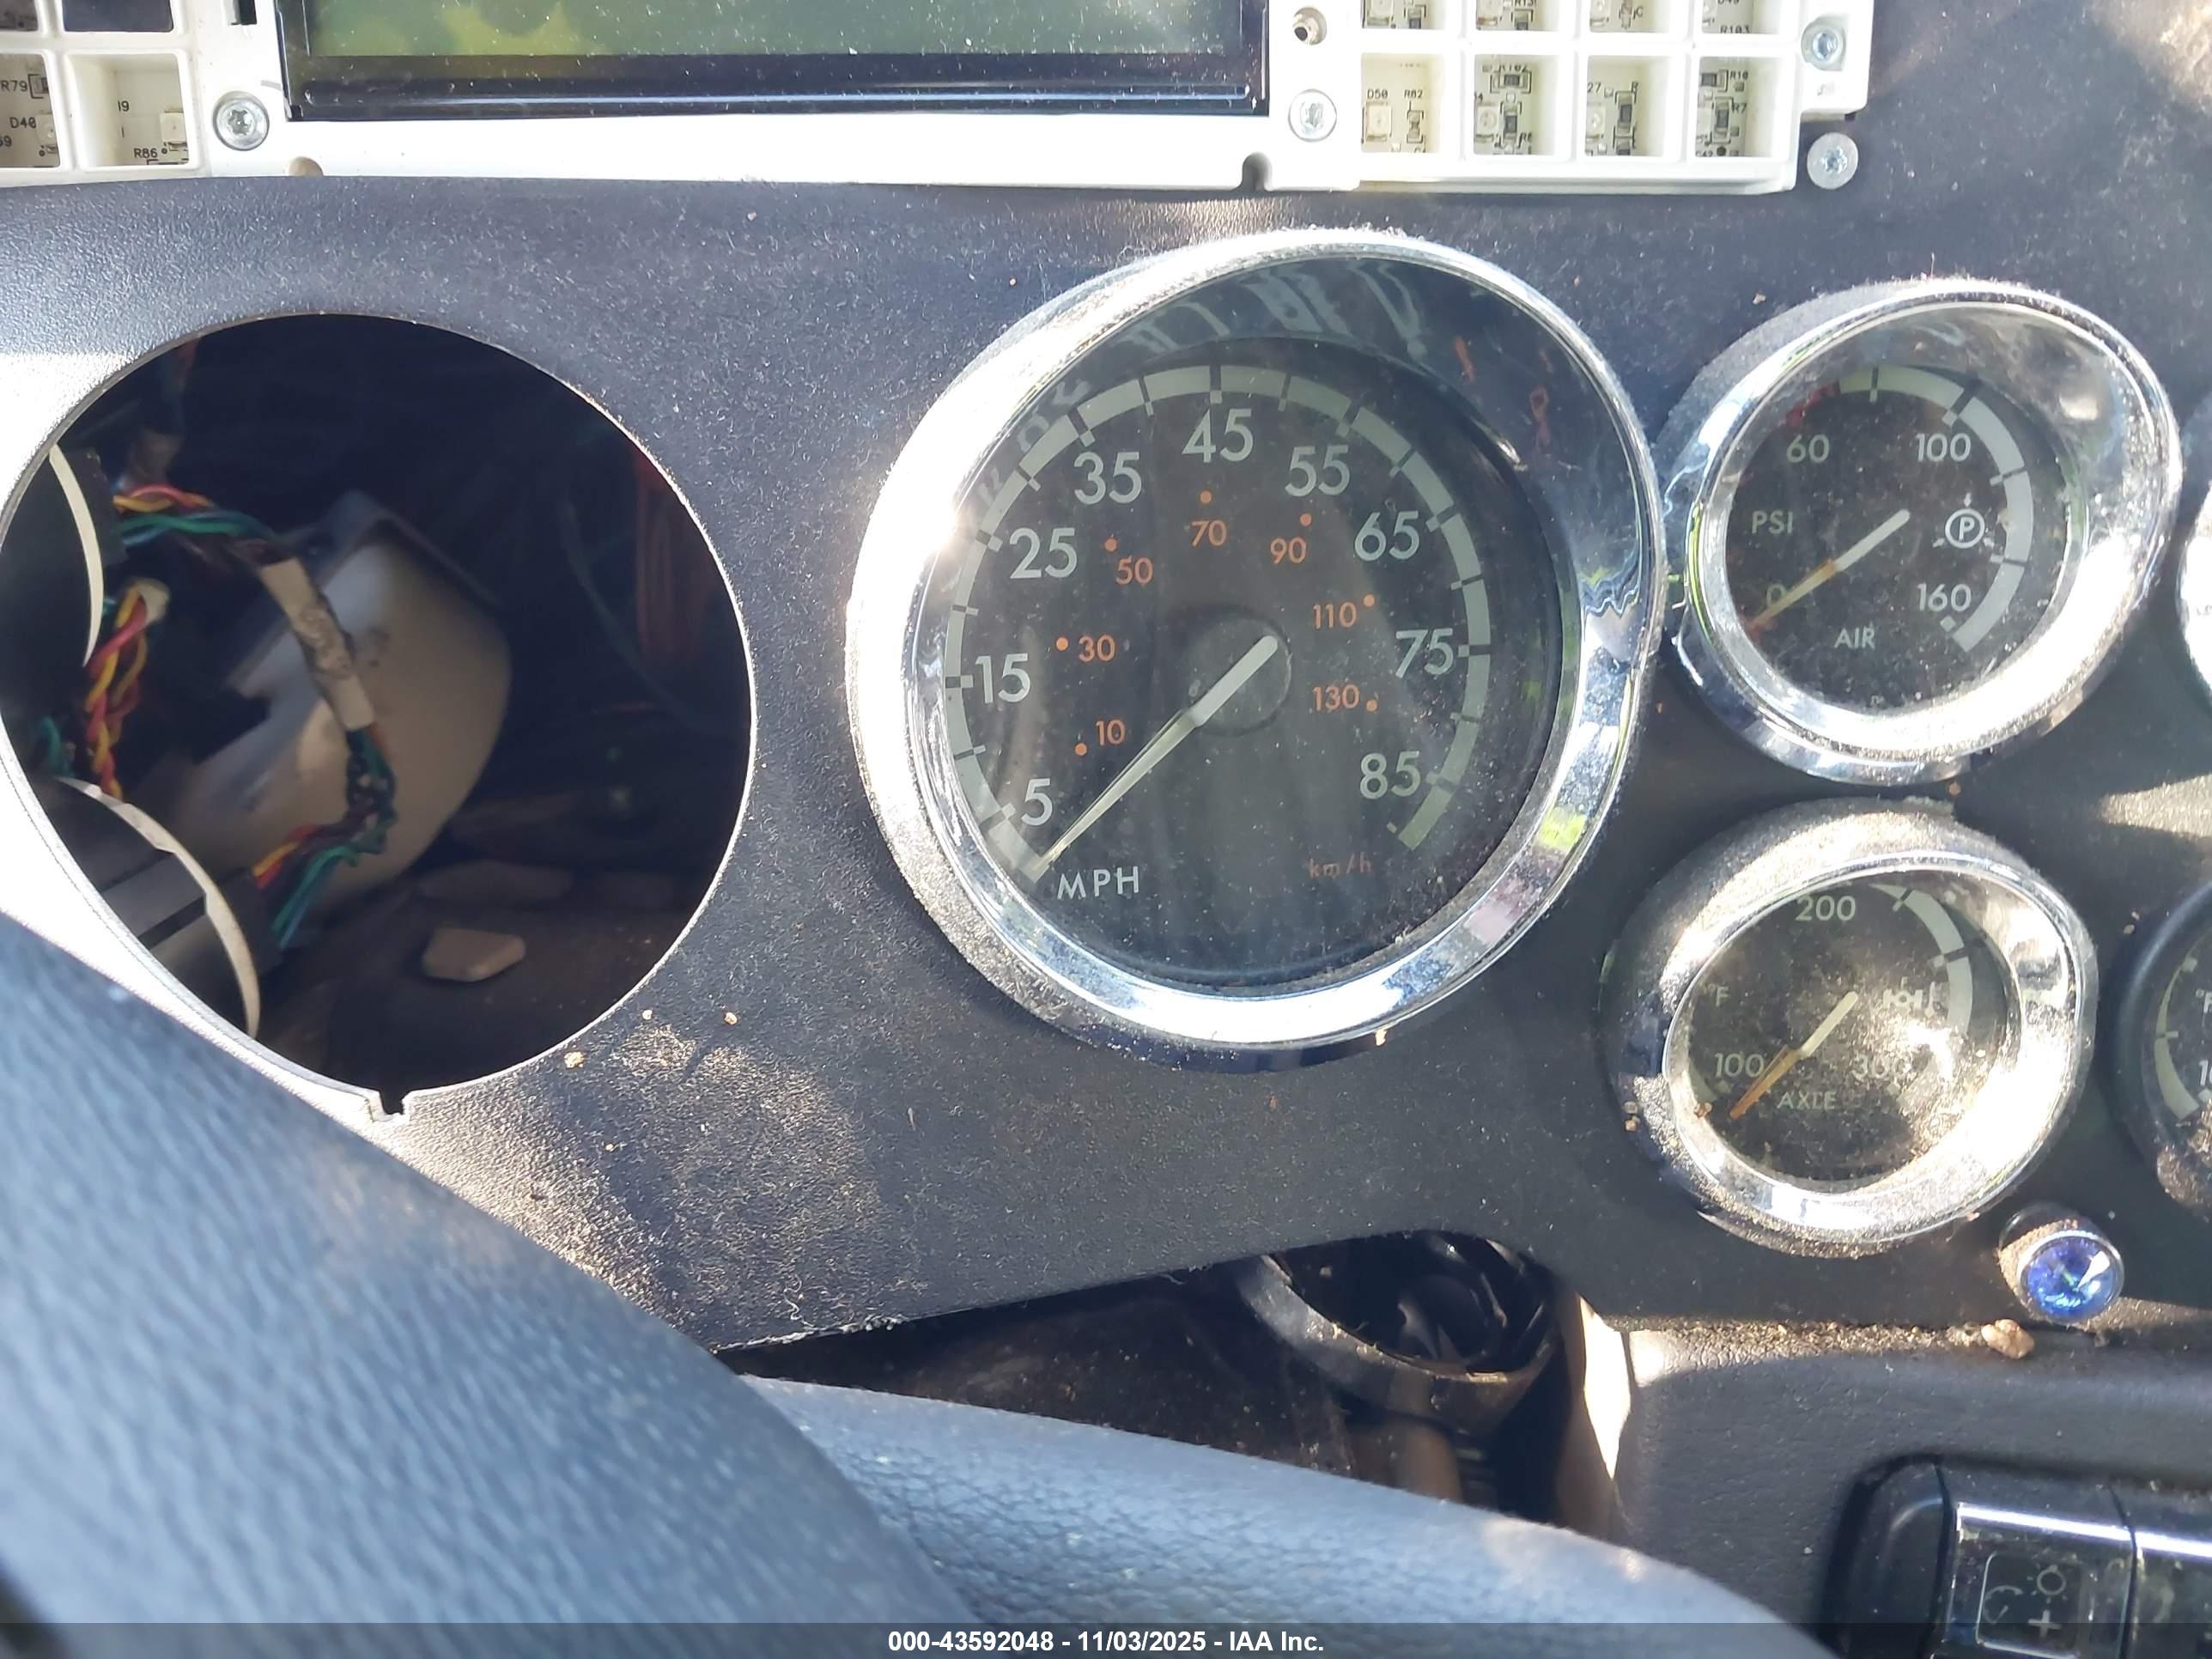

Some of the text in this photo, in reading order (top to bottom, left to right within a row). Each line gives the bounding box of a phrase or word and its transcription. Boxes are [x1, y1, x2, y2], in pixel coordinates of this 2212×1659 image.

[9, 116, 36, 129] D40
[133, 147, 158, 159] R86
[1182, 409, 1254, 463] 45
[1786, 434, 1830, 463] 60
[1915, 433, 1972, 462] 100
[1074, 452, 1142, 505] 35
[1285, 445, 1351, 496] 55
[1191, 520, 1227, 547] 70
[1354, 510, 1419, 561] 65
[1751, 510, 1793, 534] PSI
[1009, 527, 1078, 579] 25
[1270, 537, 1307, 564] 90
[1115, 556, 1154, 586] 50
[1917, 584, 1972, 611] 160
[1312, 602, 1358, 629] 110
[1078, 635, 1116, 662] 30
[1834, 627, 1875, 649] AIR
[1395, 628, 1454, 678] 75
[975, 653, 1030, 703] 15
[1313, 684, 1360, 711] 130
[1095, 720, 1126, 746] 10
[1359, 750, 1421, 799] 85
[1021, 778, 1053, 826] 5
[1057, 866, 1139, 900] MPH
[1795, 895, 1856, 921] 200
[1714, 1053, 1765, 1078] 100
[1776, 1090, 1837, 1109] AXLE
